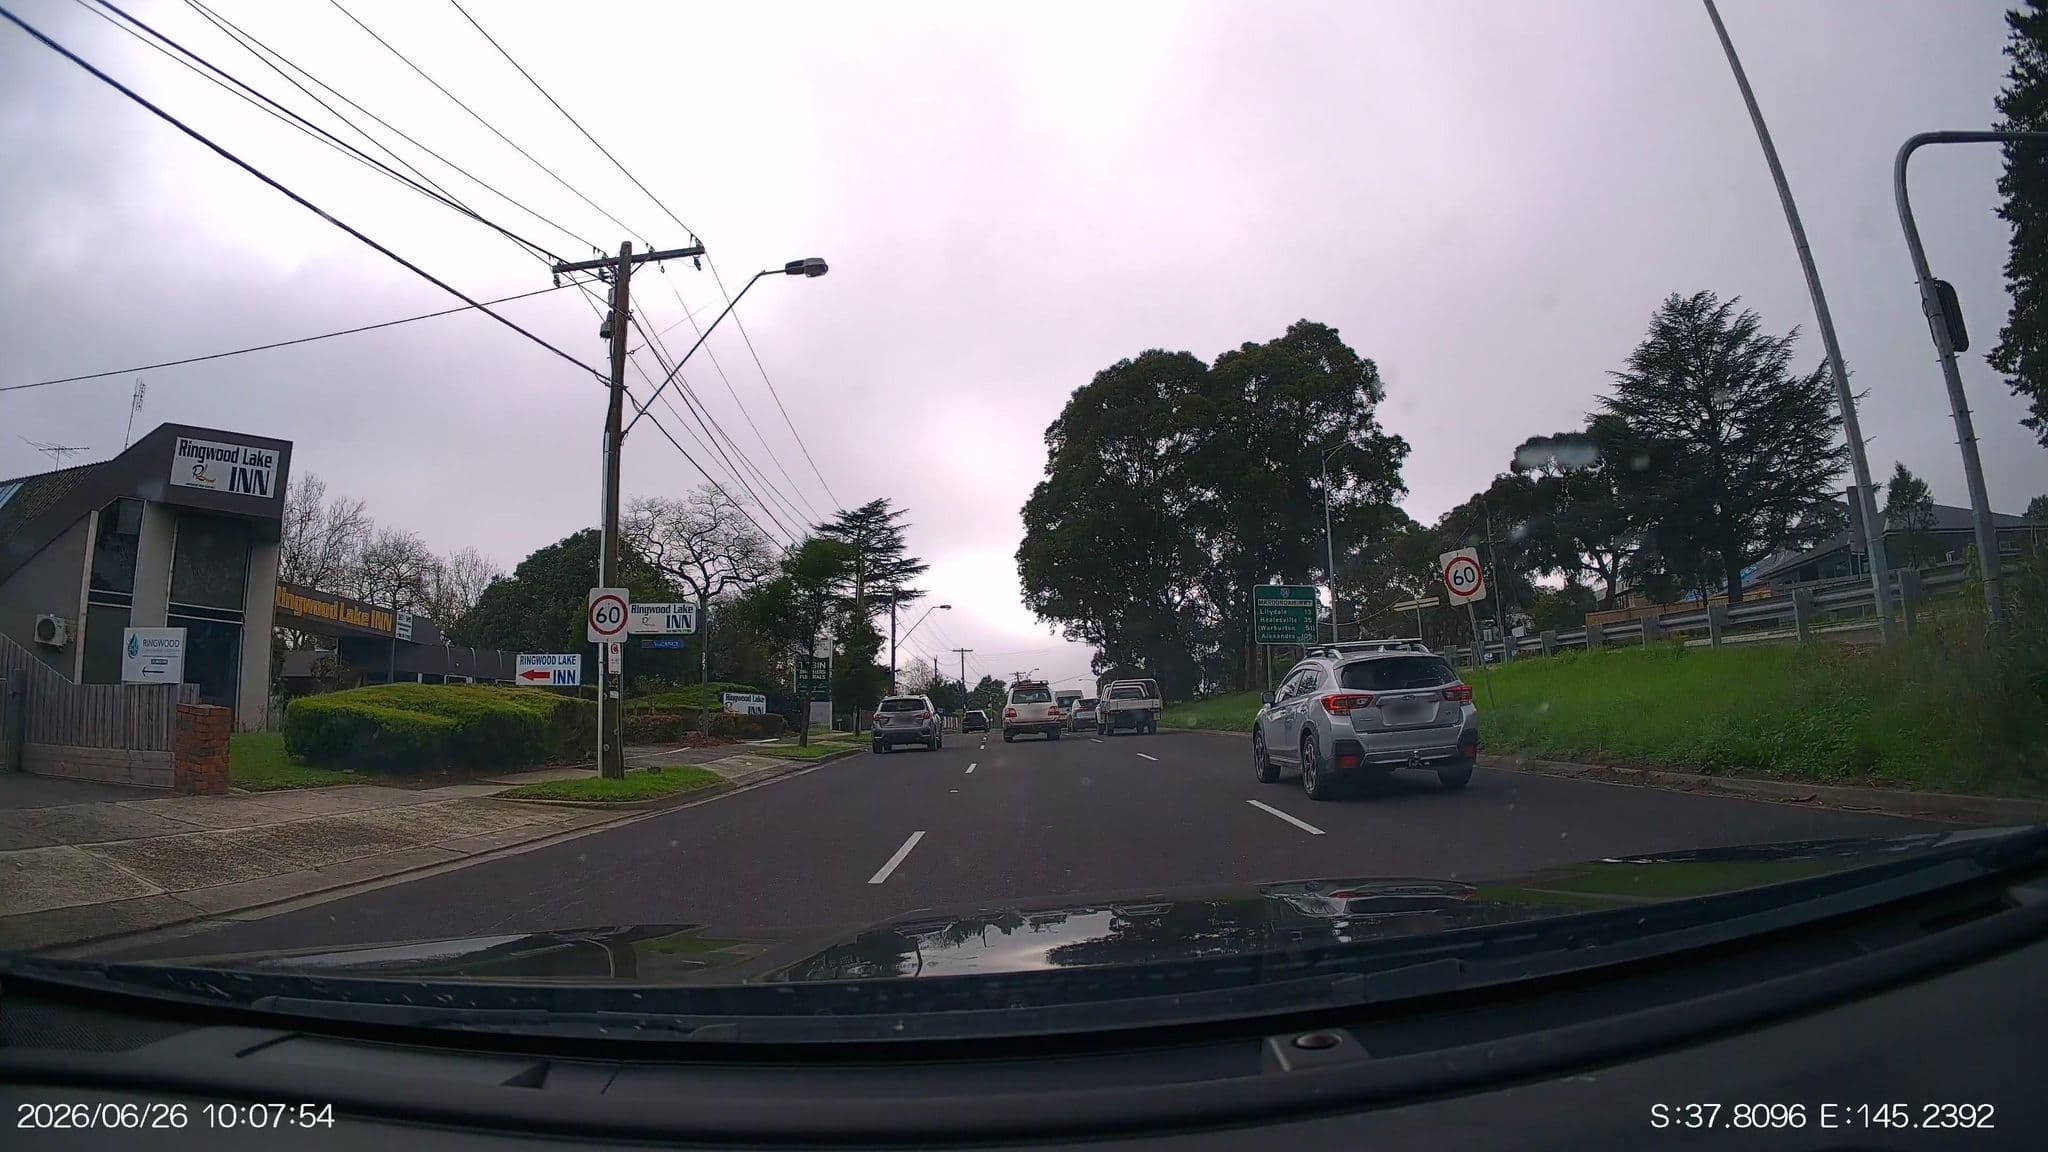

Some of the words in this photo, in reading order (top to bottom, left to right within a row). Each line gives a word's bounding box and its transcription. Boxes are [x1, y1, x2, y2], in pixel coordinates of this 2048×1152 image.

[178, 439, 240, 463] Ringwood
[242, 448, 272, 468] Lake
[228, 466, 270, 495] INN
[1453, 566, 1475, 585] 60
[339, 602, 369, 626] Lake
[370, 609, 393, 632] INN
[596, 606, 620, 624] 60
[631, 604, 671, 616] Ringwood
[673, 605, 693, 614] Lake
[1260, 608, 1287, 616] Lilydale
[666, 614, 692, 629] INN
[142, 639, 180, 648] RINGWOOD
[520, 655, 556, 665] RINGWOOD
[558, 655, 576, 665] LAKE
[553, 669, 576, 684] INN
[725, 693, 752, 703] Ringwood
[752, 695, 765, 703] Lake
